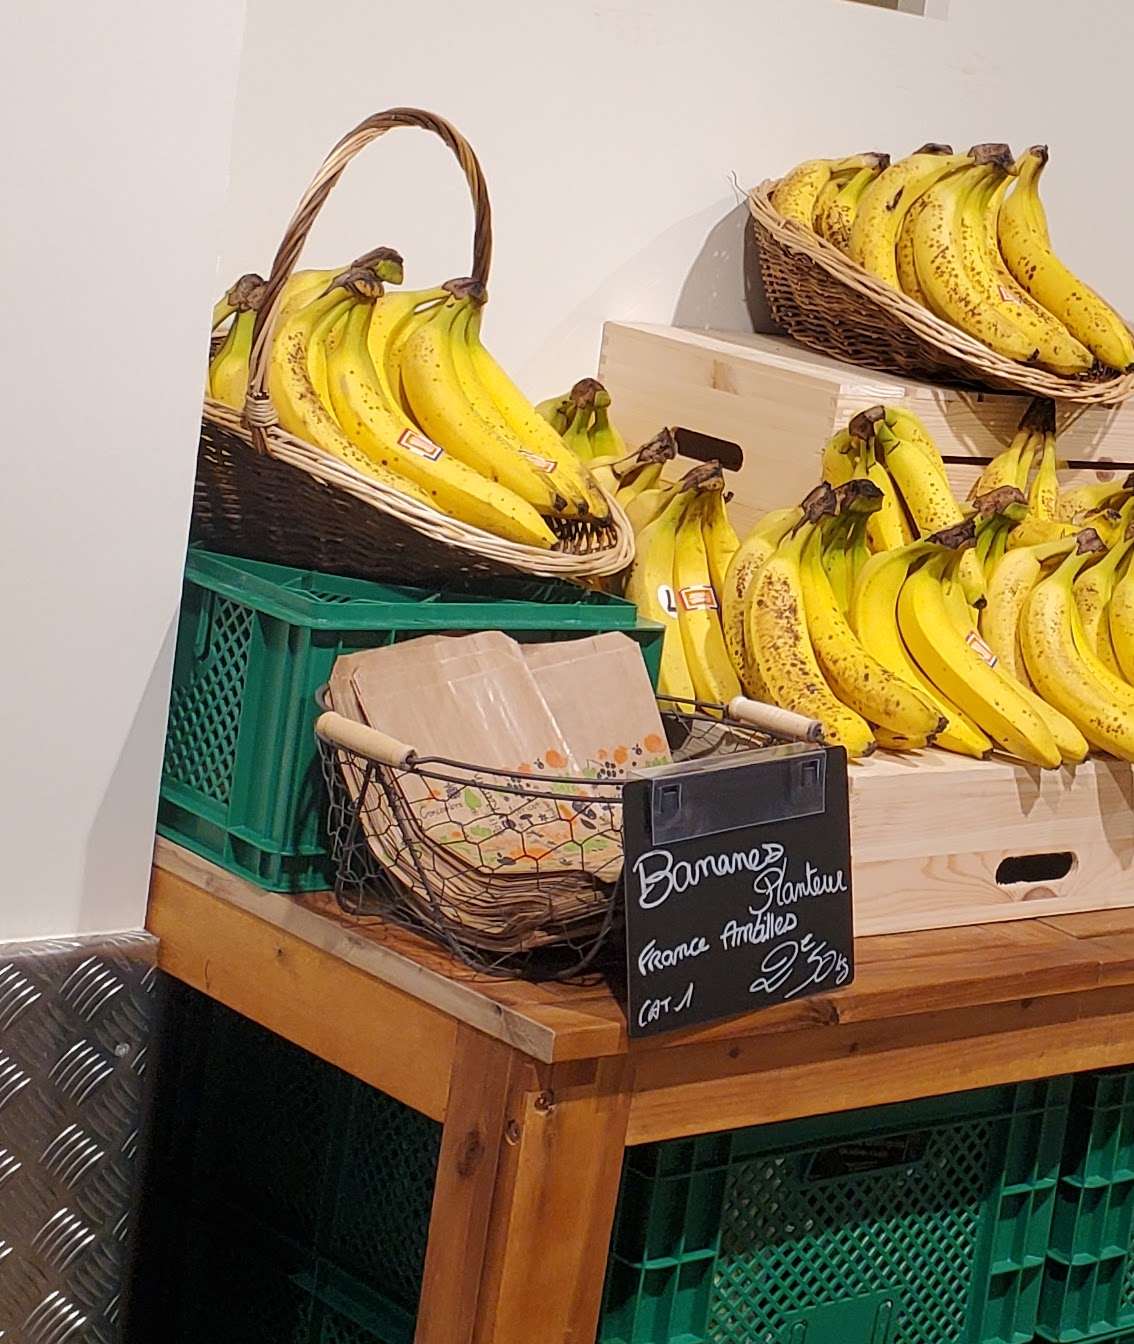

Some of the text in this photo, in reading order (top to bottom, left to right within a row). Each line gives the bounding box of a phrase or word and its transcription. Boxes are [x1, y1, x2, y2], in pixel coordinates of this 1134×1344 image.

[632, 843, 785, 910] Bananes
[749, 856, 848, 915] Planteur
[637, 939, 711, 977] France
[637, 996, 672, 1027] CAT
